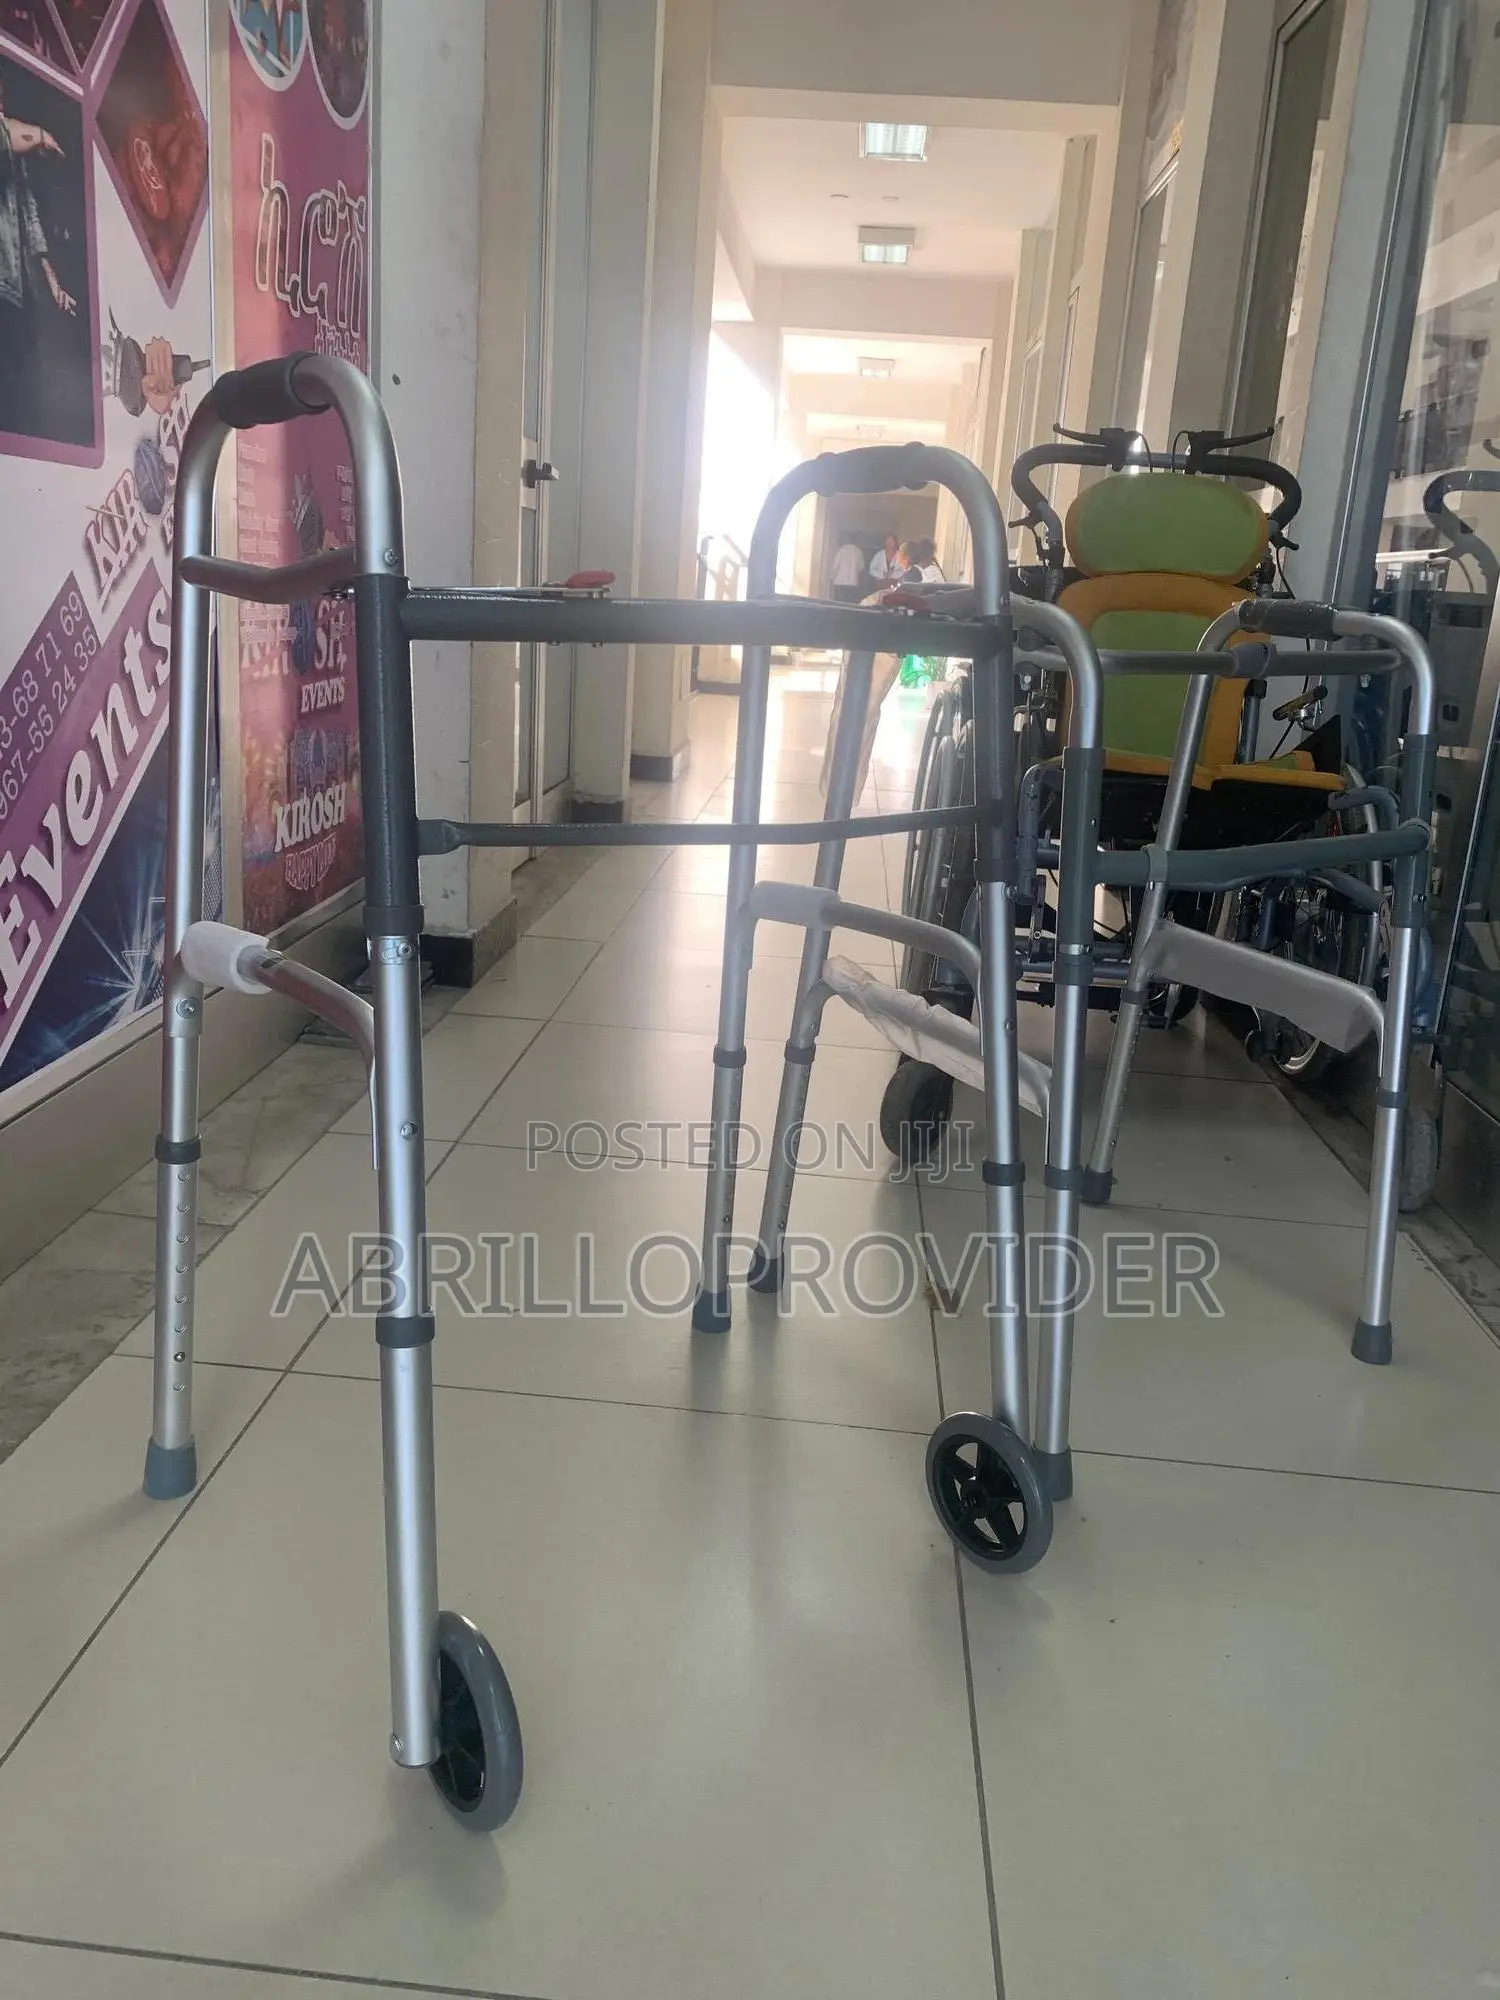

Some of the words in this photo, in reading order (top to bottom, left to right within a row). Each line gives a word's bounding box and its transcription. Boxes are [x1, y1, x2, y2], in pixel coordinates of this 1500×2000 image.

[0, 669, 39, 760] 3-68
[35, 632, 61, 679] 71
[59, 590, 83, 637] 69
[52, 664, 77, 714] 24
[74, 625, 96, 672] 35
[301, 677, 346, 713] EVENTS
[0, 587, 172, 1010] Events
[273, 781, 347, 853] KIROSH
